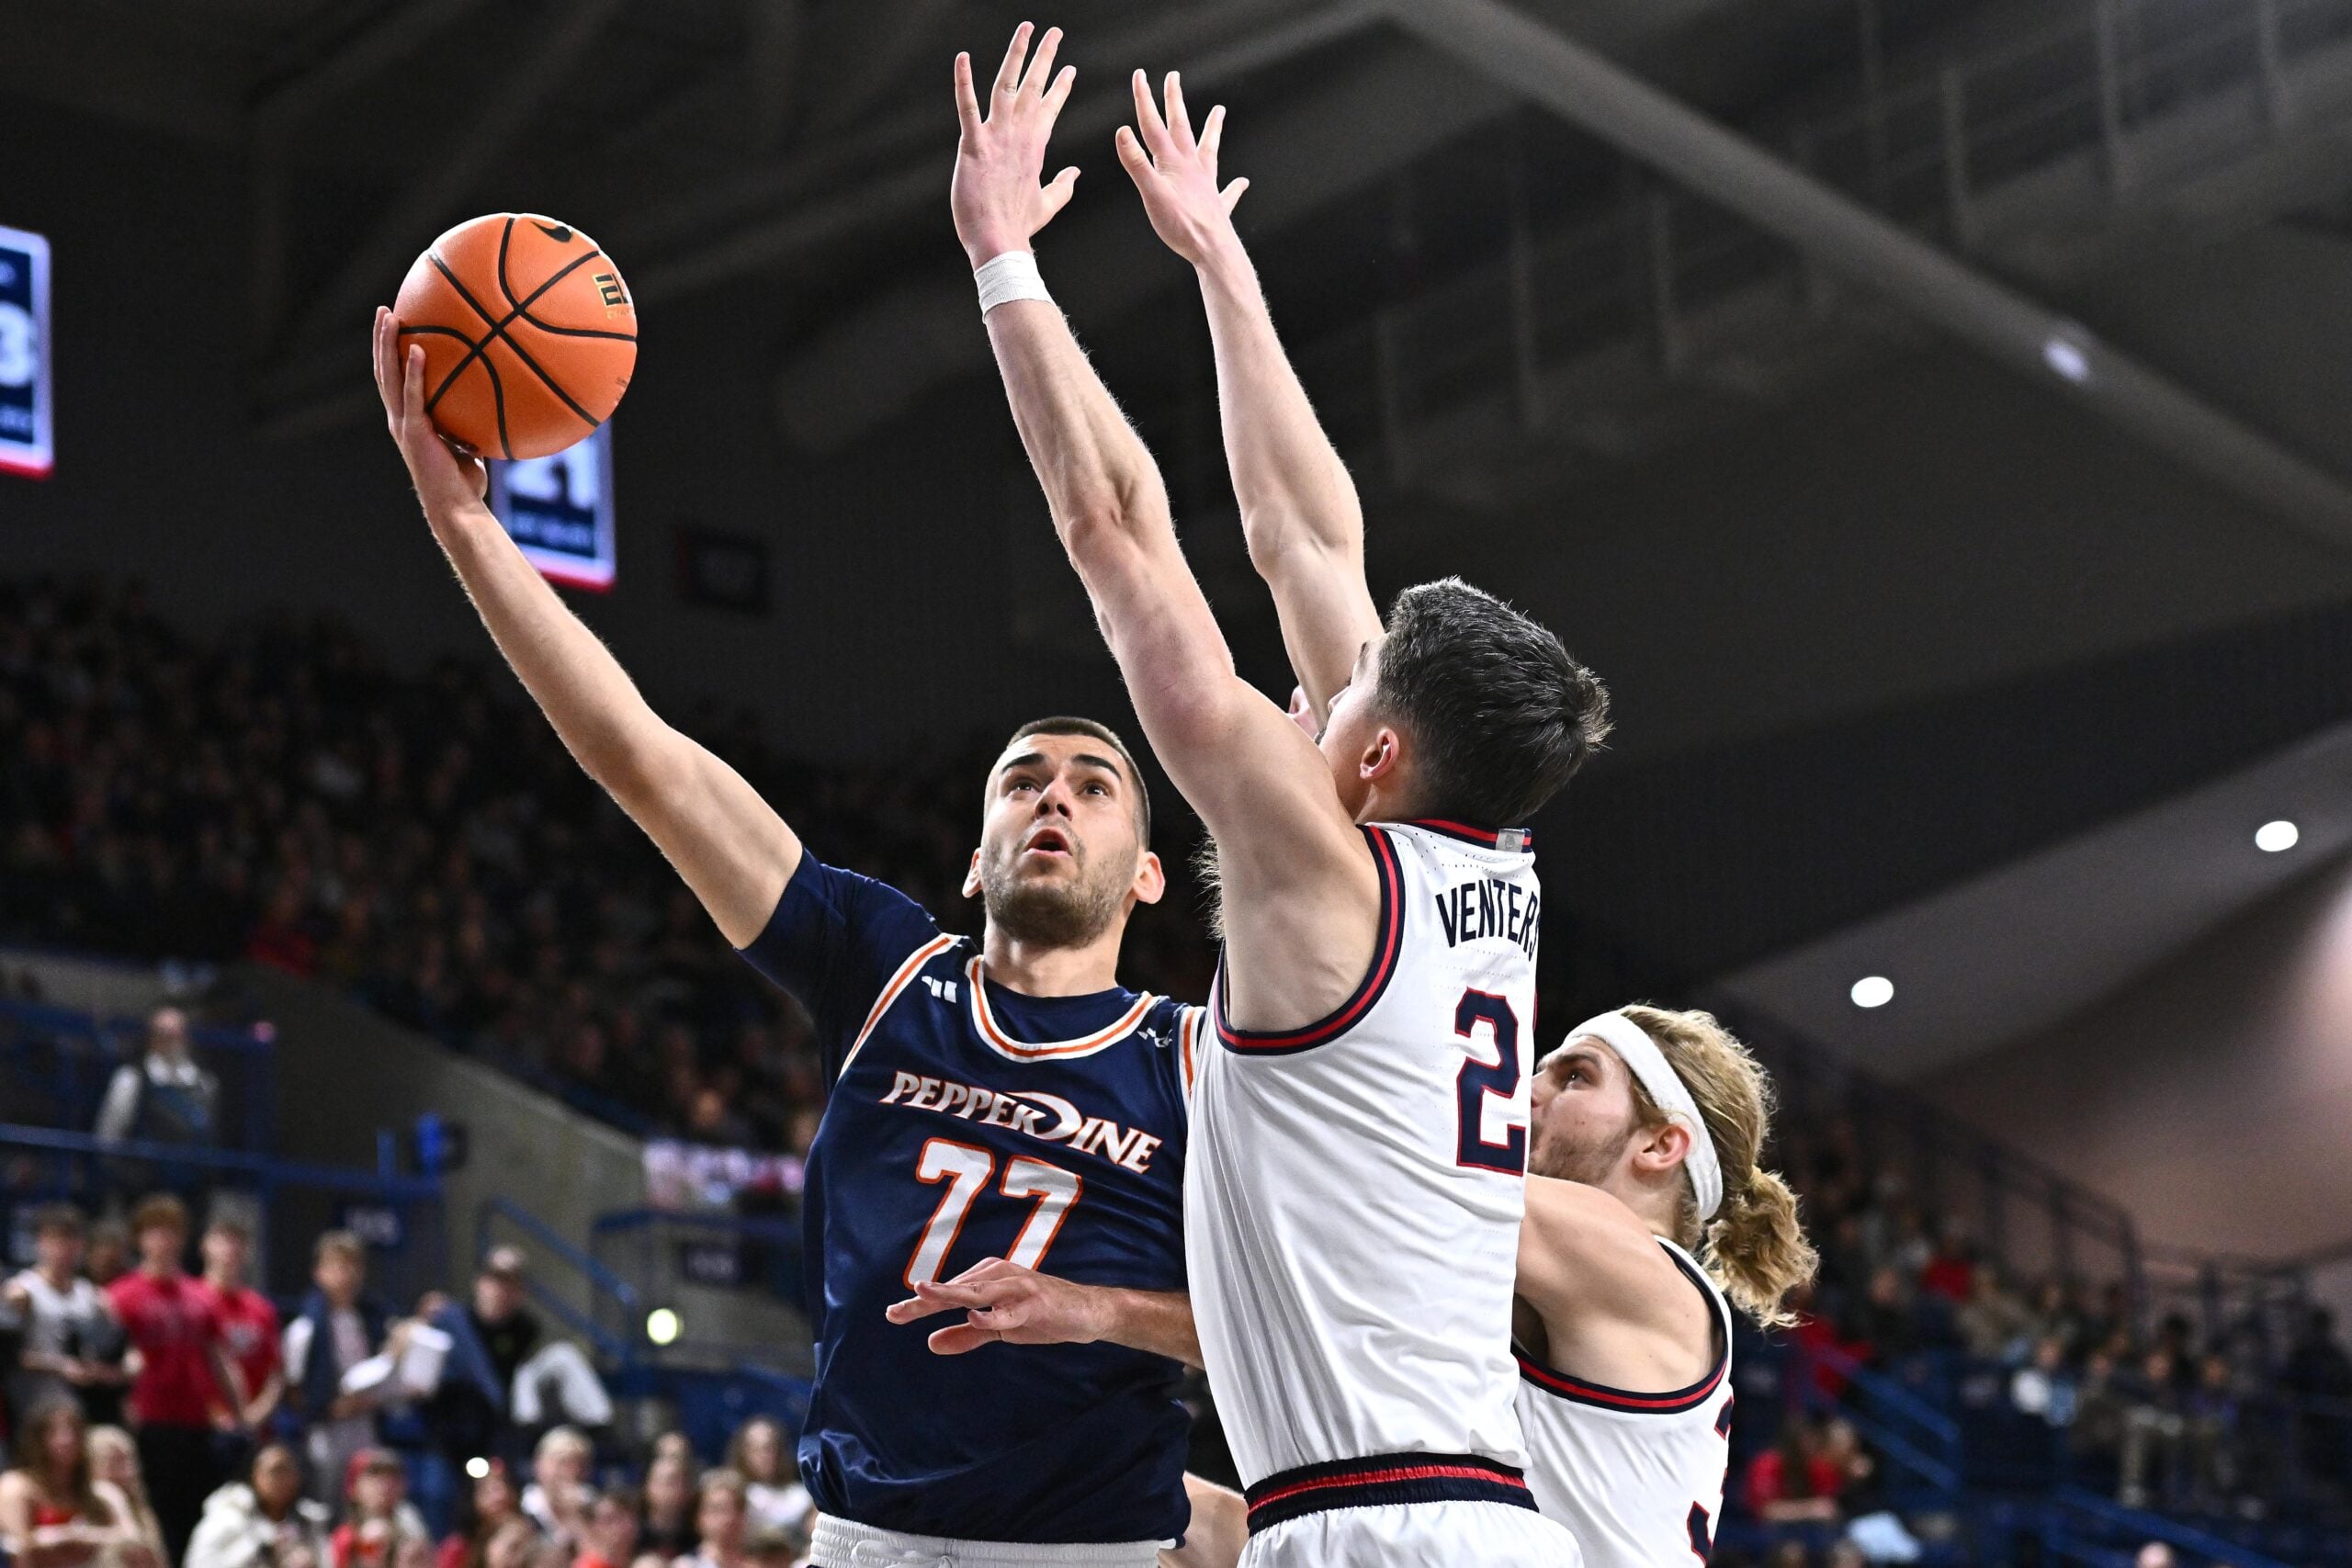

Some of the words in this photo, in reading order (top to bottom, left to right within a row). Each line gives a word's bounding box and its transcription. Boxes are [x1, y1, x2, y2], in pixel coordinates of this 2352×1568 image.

[879, 1070, 1161, 1175] PEPPERDINE
[1454, 986, 1537, 1177] 2
[902, 1136, 1083, 1291] 77
